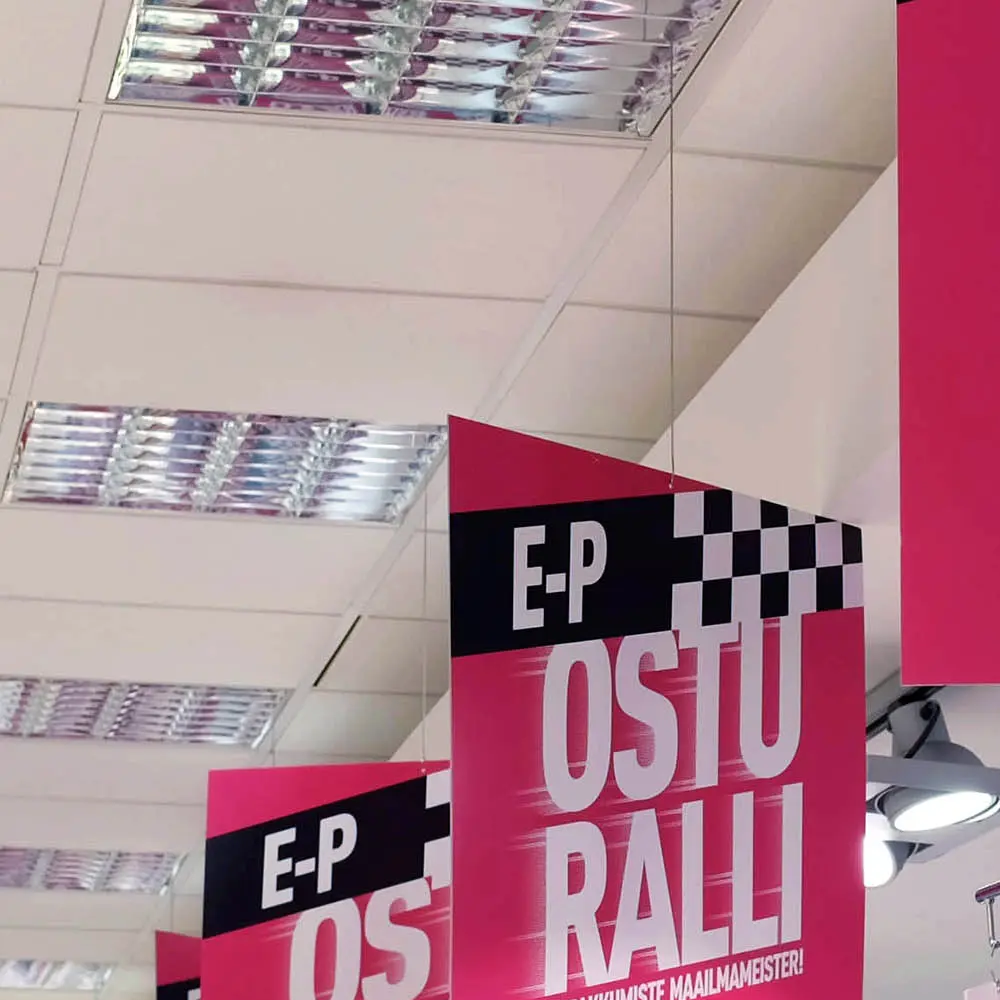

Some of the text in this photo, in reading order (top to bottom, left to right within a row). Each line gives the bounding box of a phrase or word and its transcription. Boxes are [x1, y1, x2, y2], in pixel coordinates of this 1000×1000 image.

[512, 519, 608, 631] E-P
[543, 611, 802, 813] OSTU
[261, 812, 358, 910] E-P
[543, 782, 804, 997] RALLI
